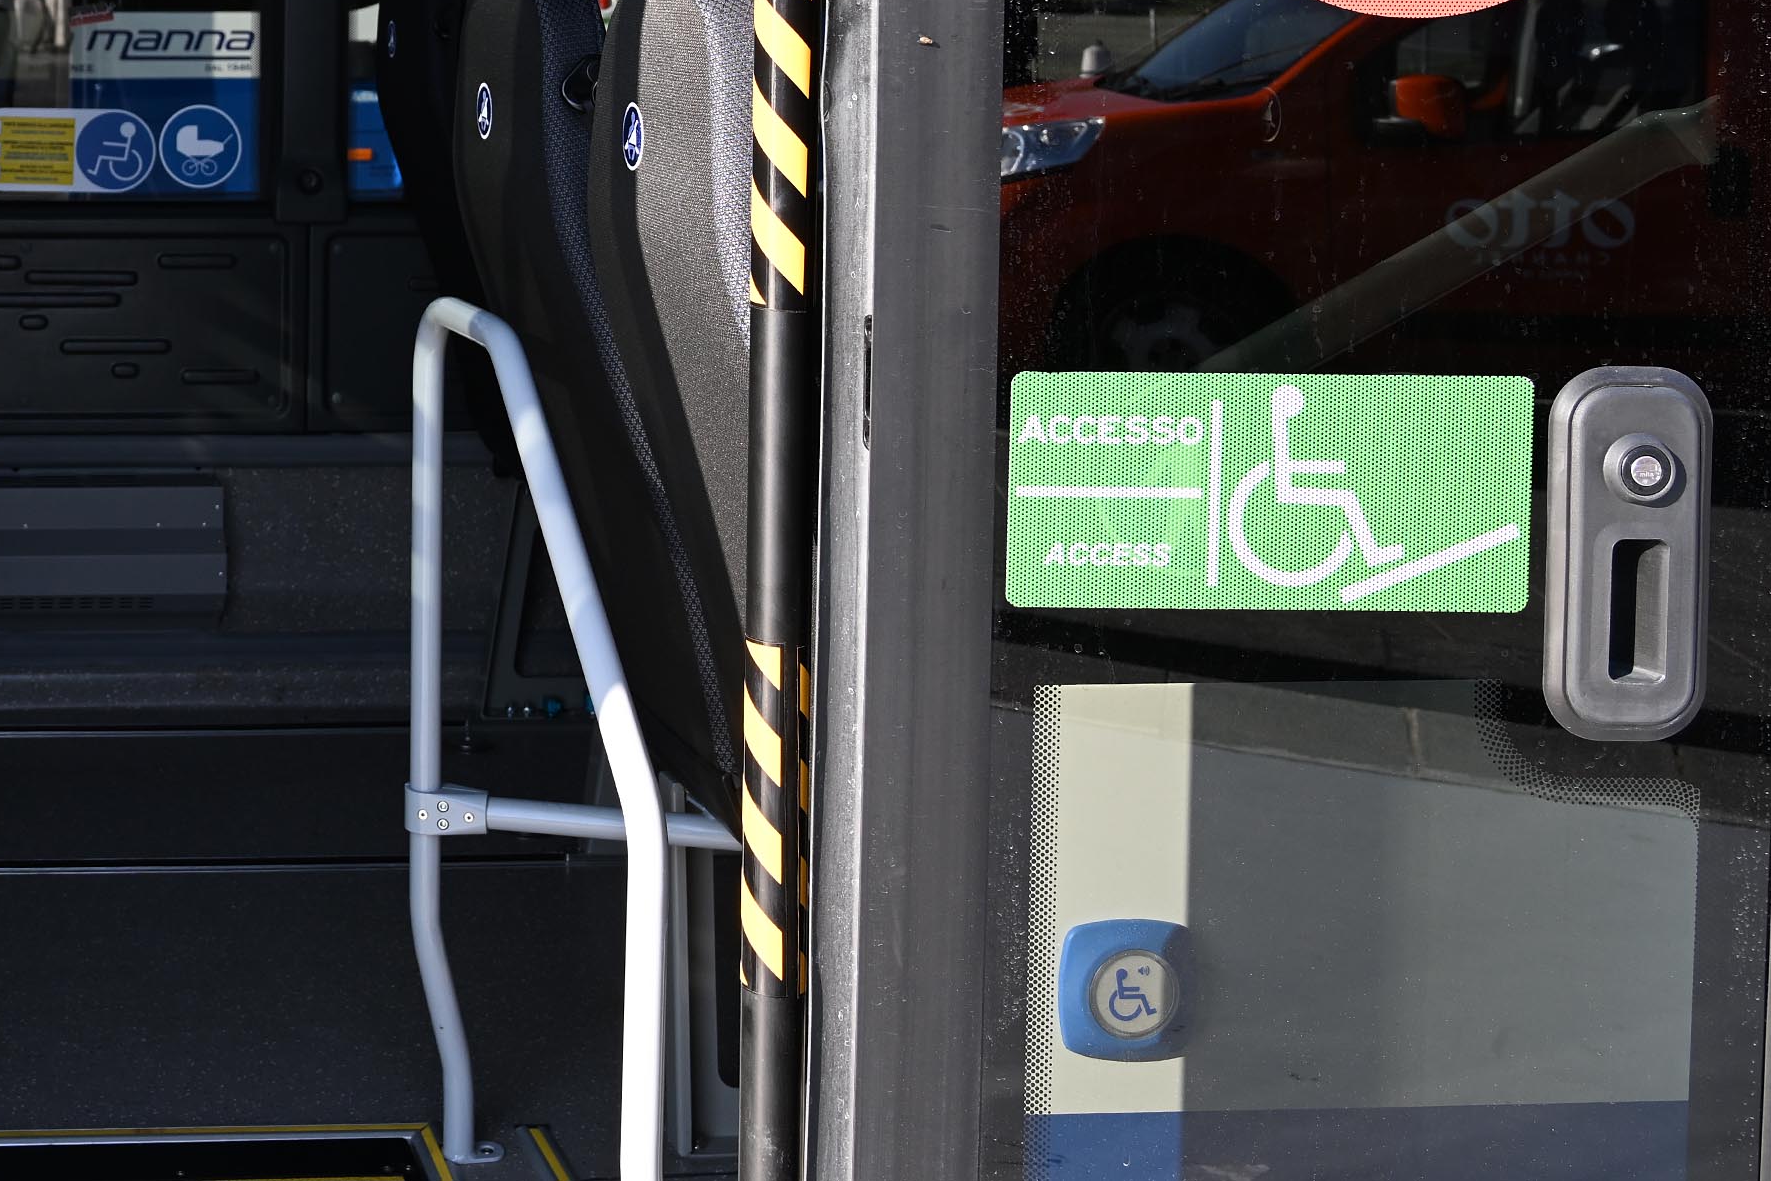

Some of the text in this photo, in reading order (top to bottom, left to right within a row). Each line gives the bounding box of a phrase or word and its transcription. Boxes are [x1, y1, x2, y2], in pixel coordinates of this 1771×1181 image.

[86, 30, 255, 60] manna
[1017, 415, 1204, 447] ACCESSO
[1042, 543, 1171, 568] ACCESS
